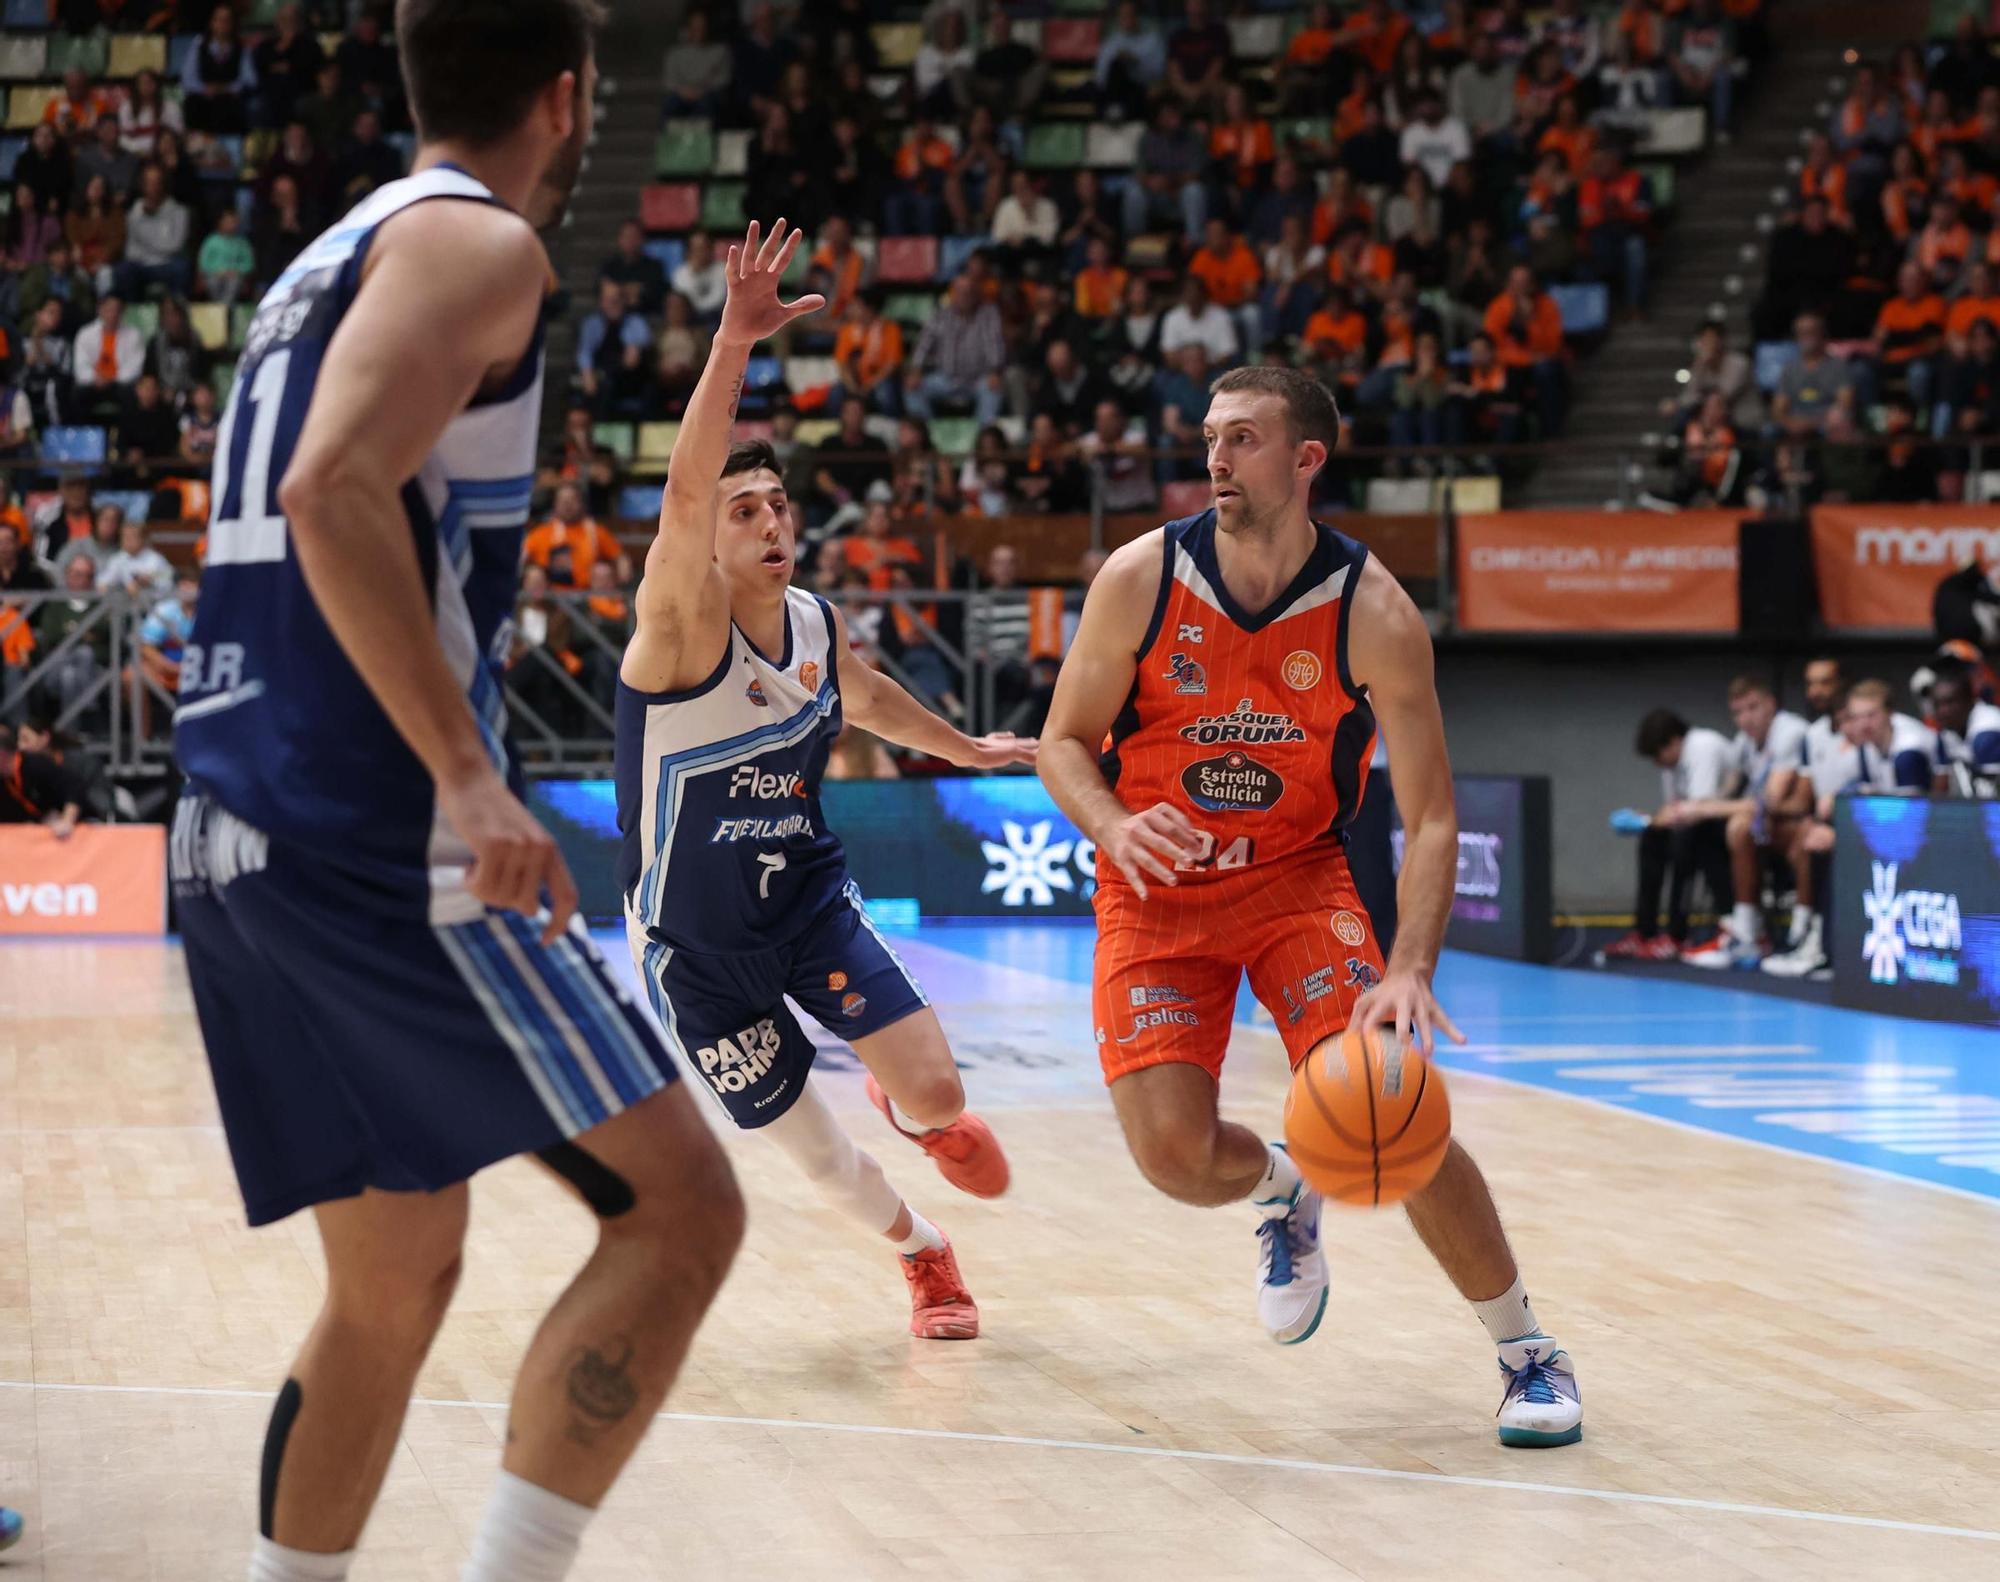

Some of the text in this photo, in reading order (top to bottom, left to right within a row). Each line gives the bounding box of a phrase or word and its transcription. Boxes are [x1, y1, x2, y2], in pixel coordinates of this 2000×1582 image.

[1199, 780, 1263, 803] Galicia
[1200, 766, 1267, 788] Estrella
[756, 851, 787, 900] 7
[1116, 1006, 1200, 1044] galicia
